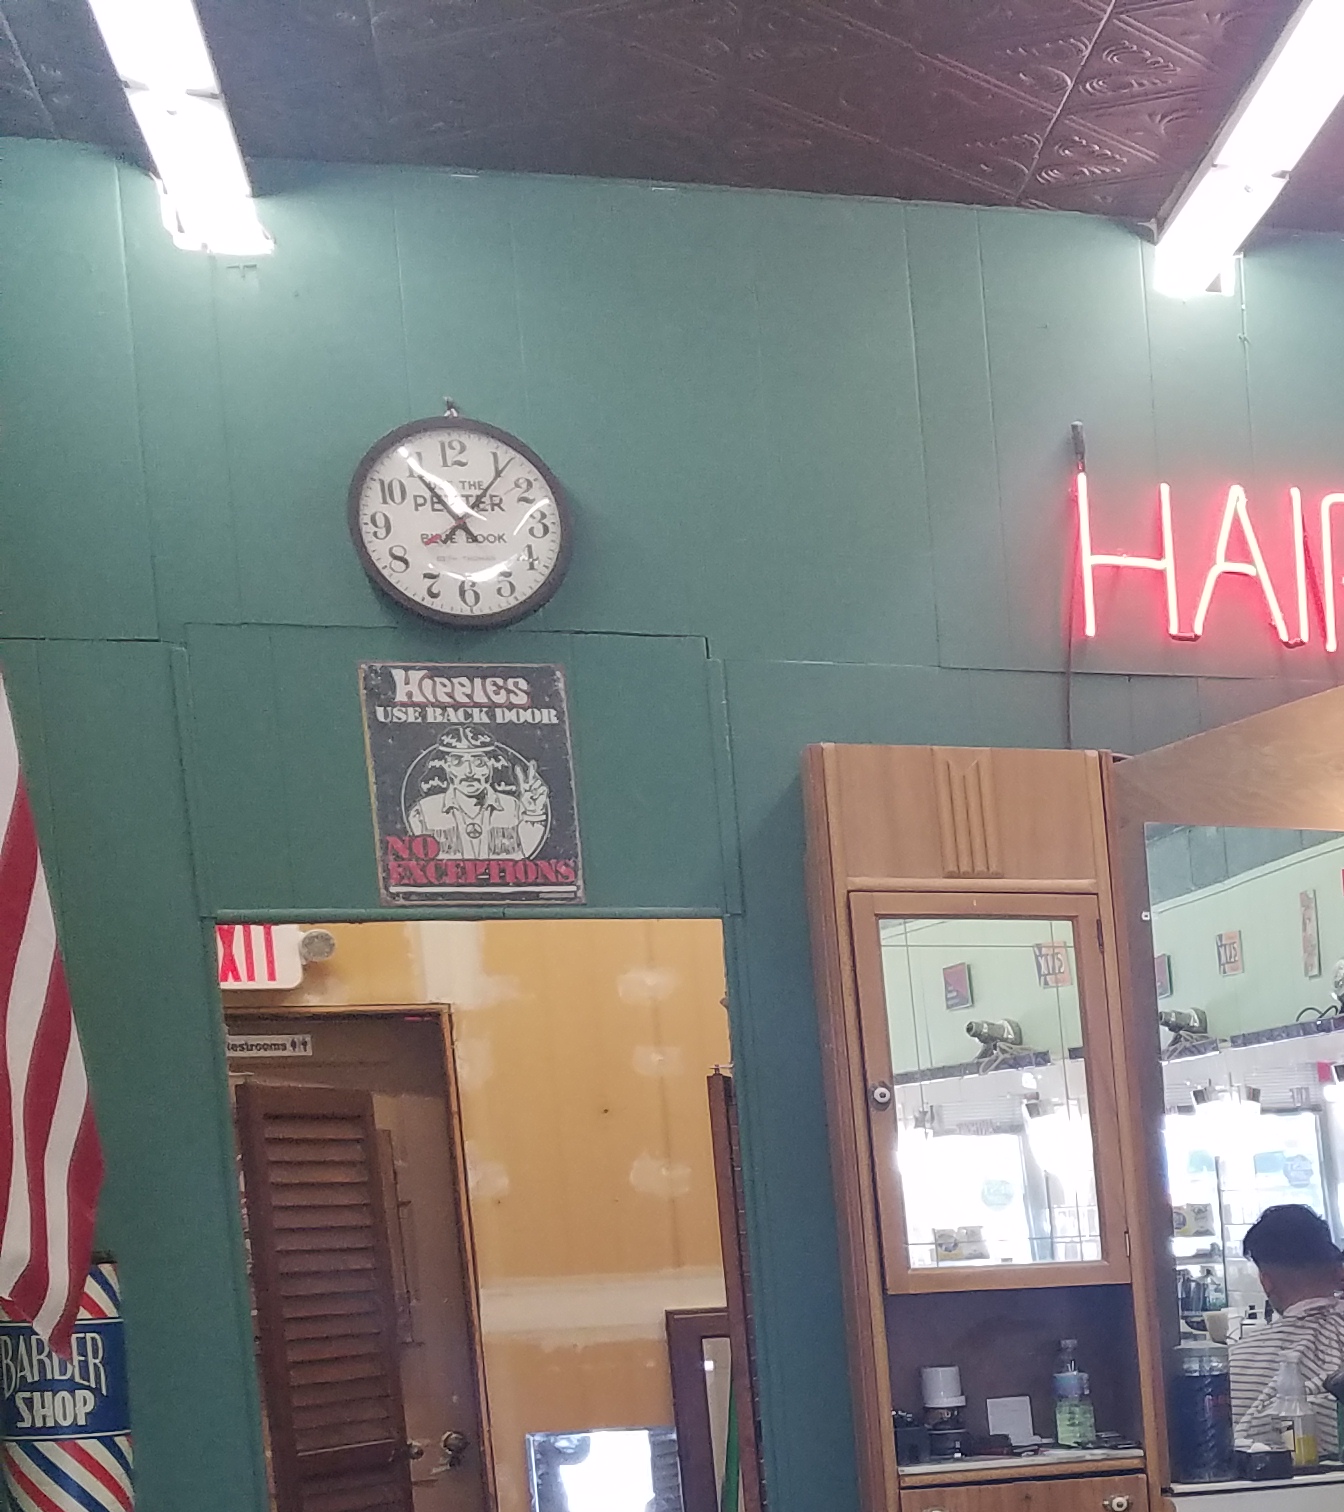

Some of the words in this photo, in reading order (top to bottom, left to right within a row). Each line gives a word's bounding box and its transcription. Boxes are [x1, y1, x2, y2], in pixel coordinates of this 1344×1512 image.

[439, 439, 468, 468] 12
[379, 478, 408, 505] 10
[514, 477, 536, 503] 2
[370, 511, 392, 540] 9
[529, 510, 549, 538] 3
[388, 545, 410, 573] 8
[517, 544, 540, 571] 4
[423, 573, 441, 599] 7
[459, 580, 481, 609] 6
[497, 571, 516, 598] 5
[376, 706, 422, 723] USE
[425, 707, 490, 723] BACK
[495, 709, 559, 724] DOOR
[385, 836, 440, 859] NO
[388, 860, 576, 884] EXCEPTIONS
[217, 925, 277, 982] XIT
[226, 1038, 288, 1053] estrooms
[15, 1389, 95, 1427] SHOP
